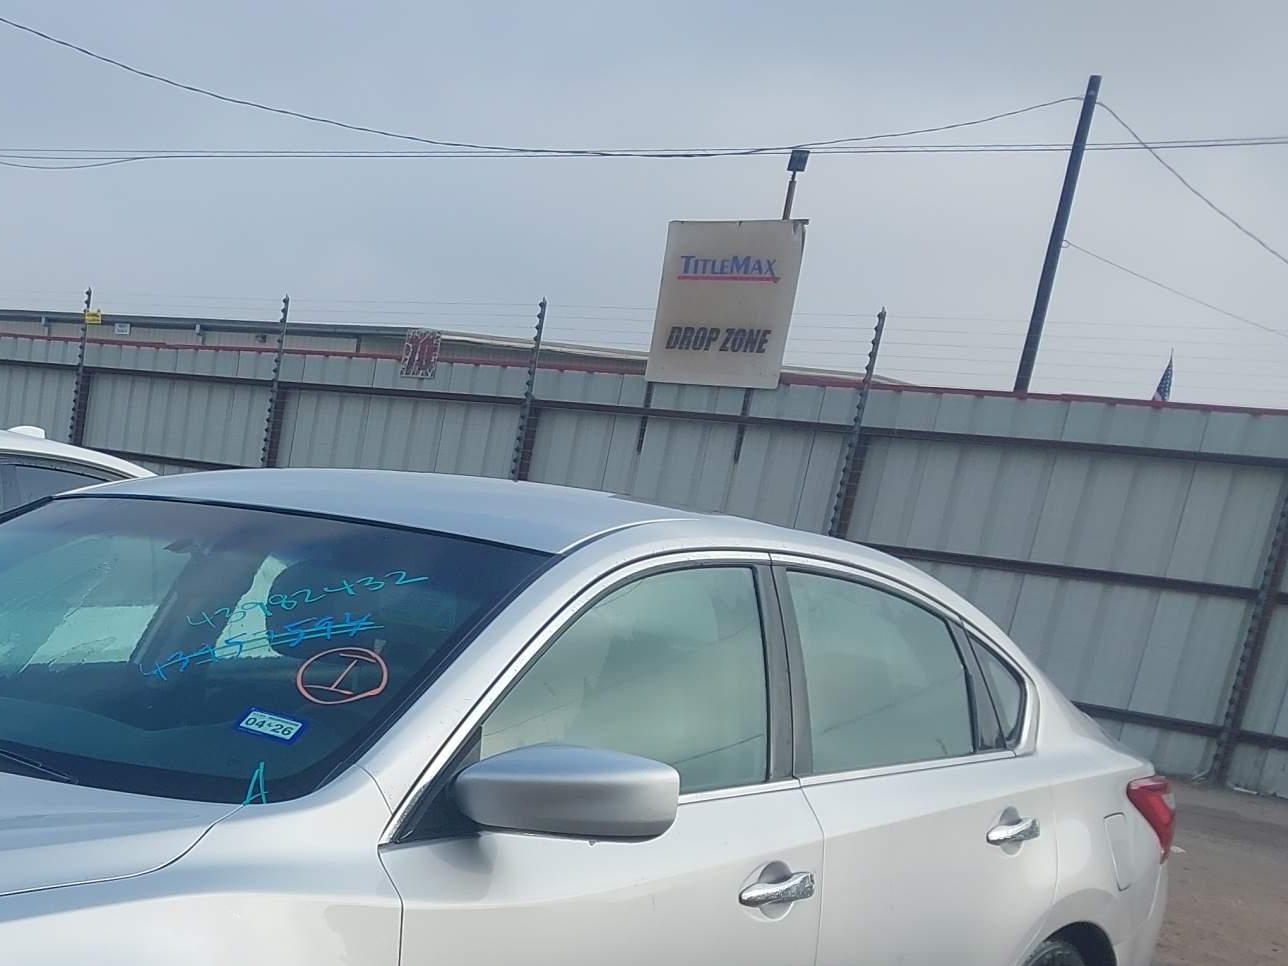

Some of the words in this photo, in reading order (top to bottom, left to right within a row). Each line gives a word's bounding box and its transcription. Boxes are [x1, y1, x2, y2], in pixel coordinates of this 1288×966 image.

[665, 326, 721, 351] DROP
[719, 328, 772, 354] ZONE
[185, 569, 429, 630] 43982432
[242, 760, 269, 806] A
